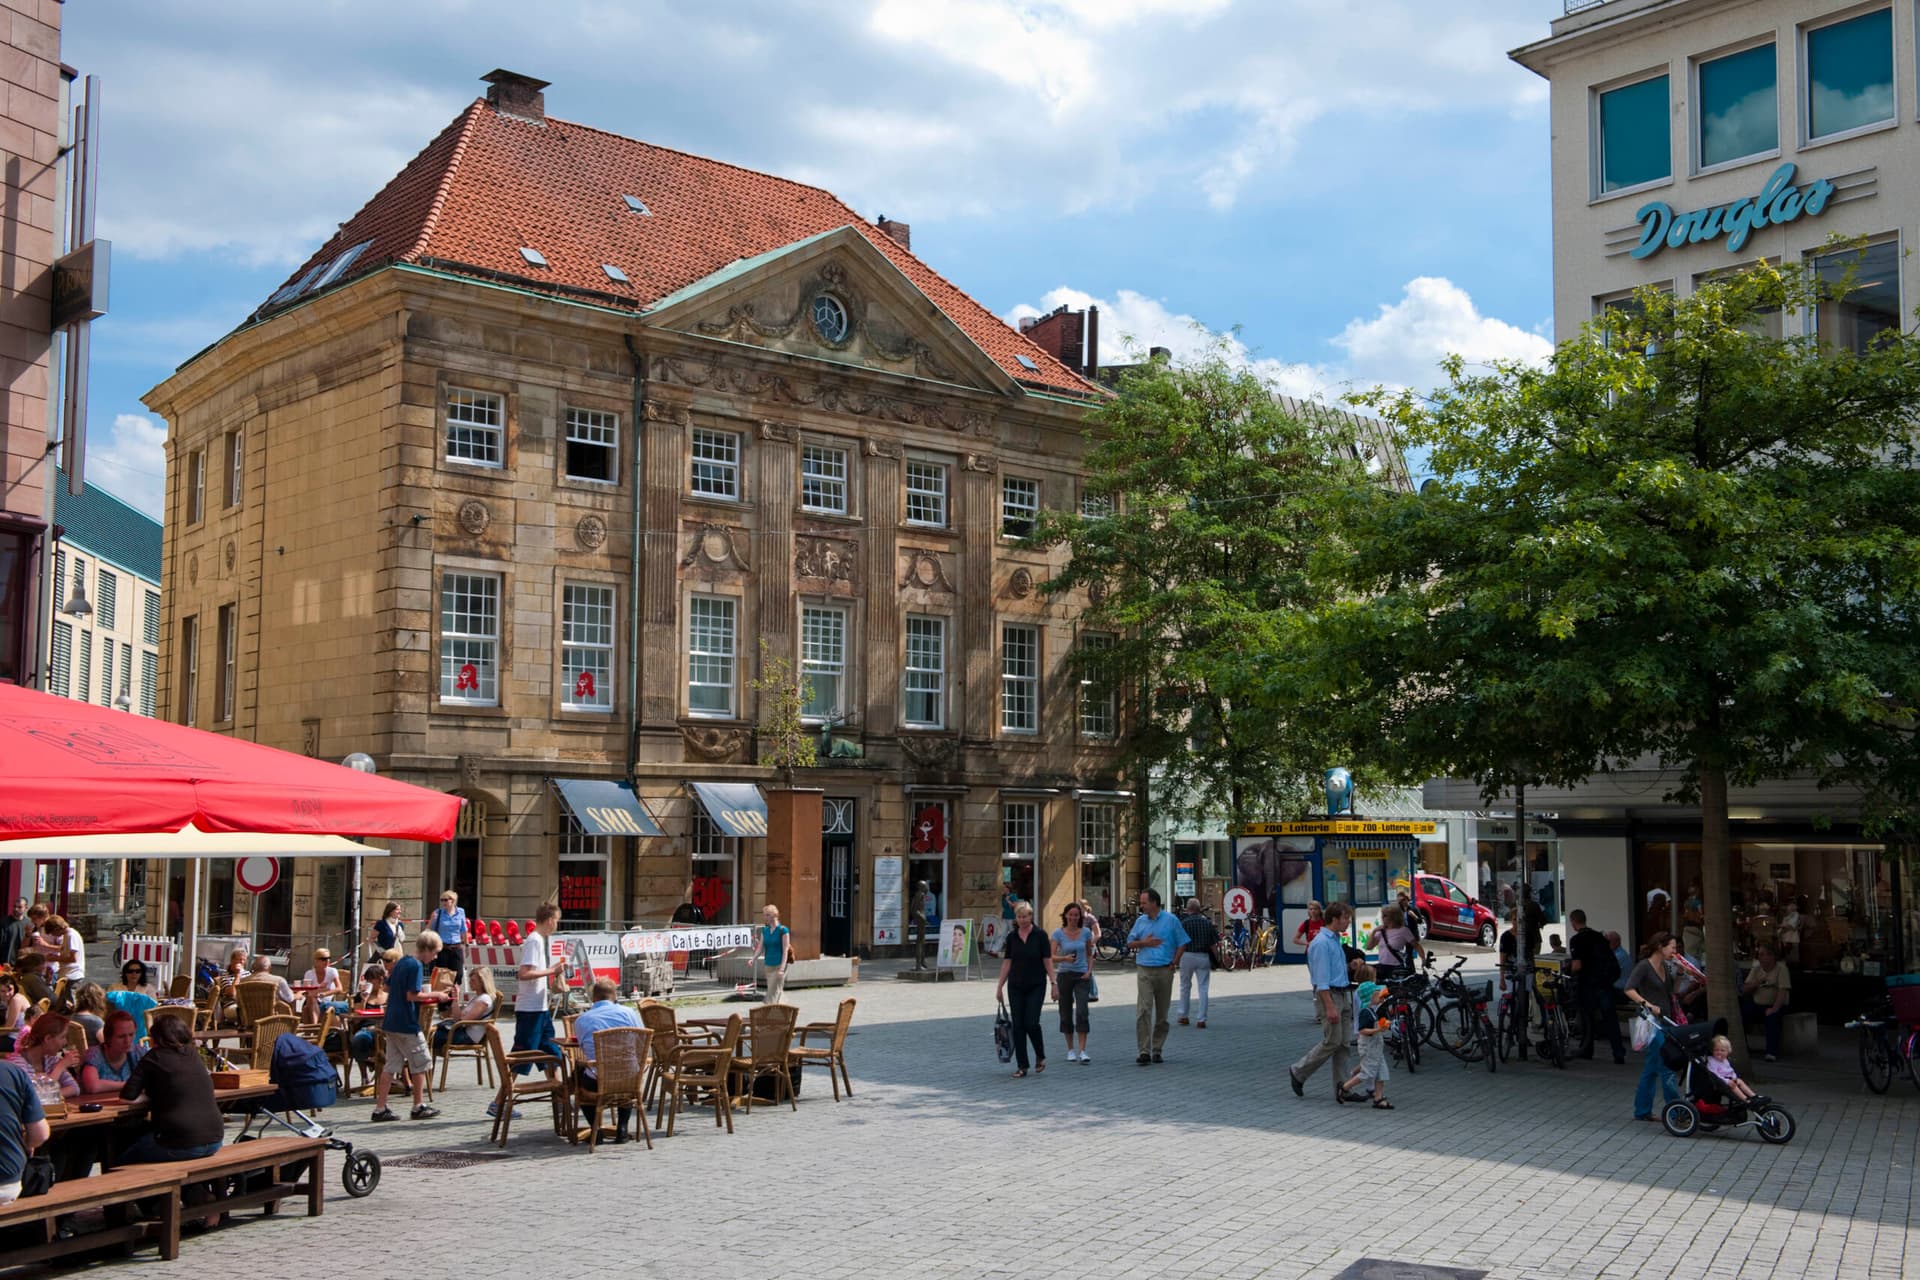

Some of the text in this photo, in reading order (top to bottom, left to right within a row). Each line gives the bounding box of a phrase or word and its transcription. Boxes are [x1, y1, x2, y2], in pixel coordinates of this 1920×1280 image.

[1629, 162, 1836, 260] Douglas
[1264, 824, 1283, 833] ZOO
[1289, 823, 1330, 833] Lotterie
[1363, 823, 1377, 832] ZOO
[1382, 823, 1411, 832] Lotterie
[672, 930, 749, 949] Café-Garten
